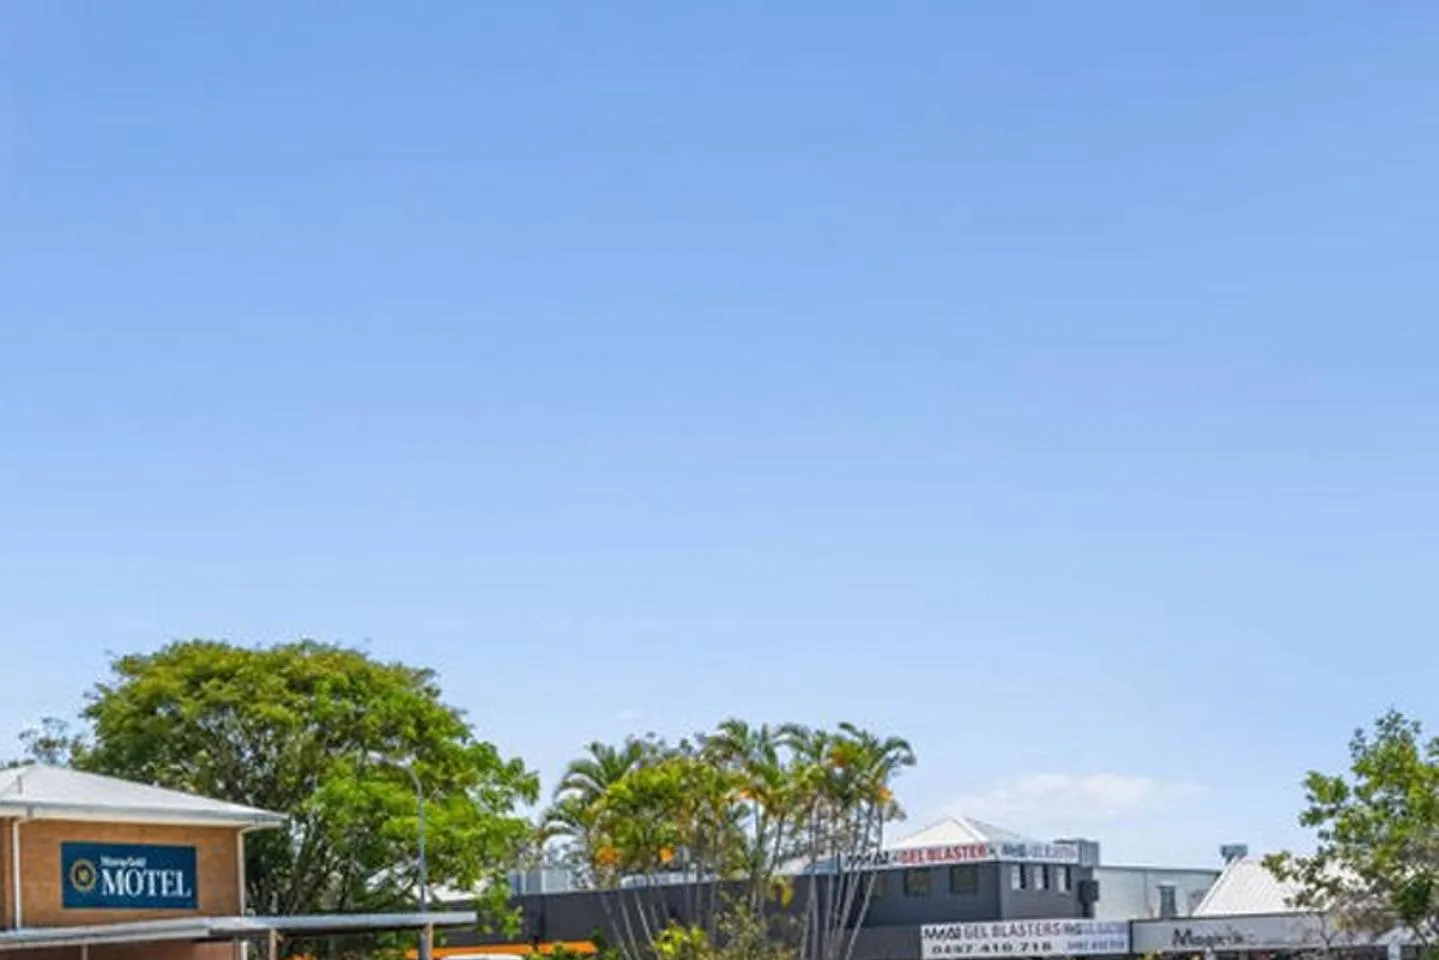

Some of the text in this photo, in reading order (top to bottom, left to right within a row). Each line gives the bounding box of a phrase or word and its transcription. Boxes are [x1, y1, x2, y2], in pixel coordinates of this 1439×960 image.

[101, 868, 192, 897] MOTEL
[964, 925, 988, 939] GEL
[992, 922, 1060, 938] BLASTERS
